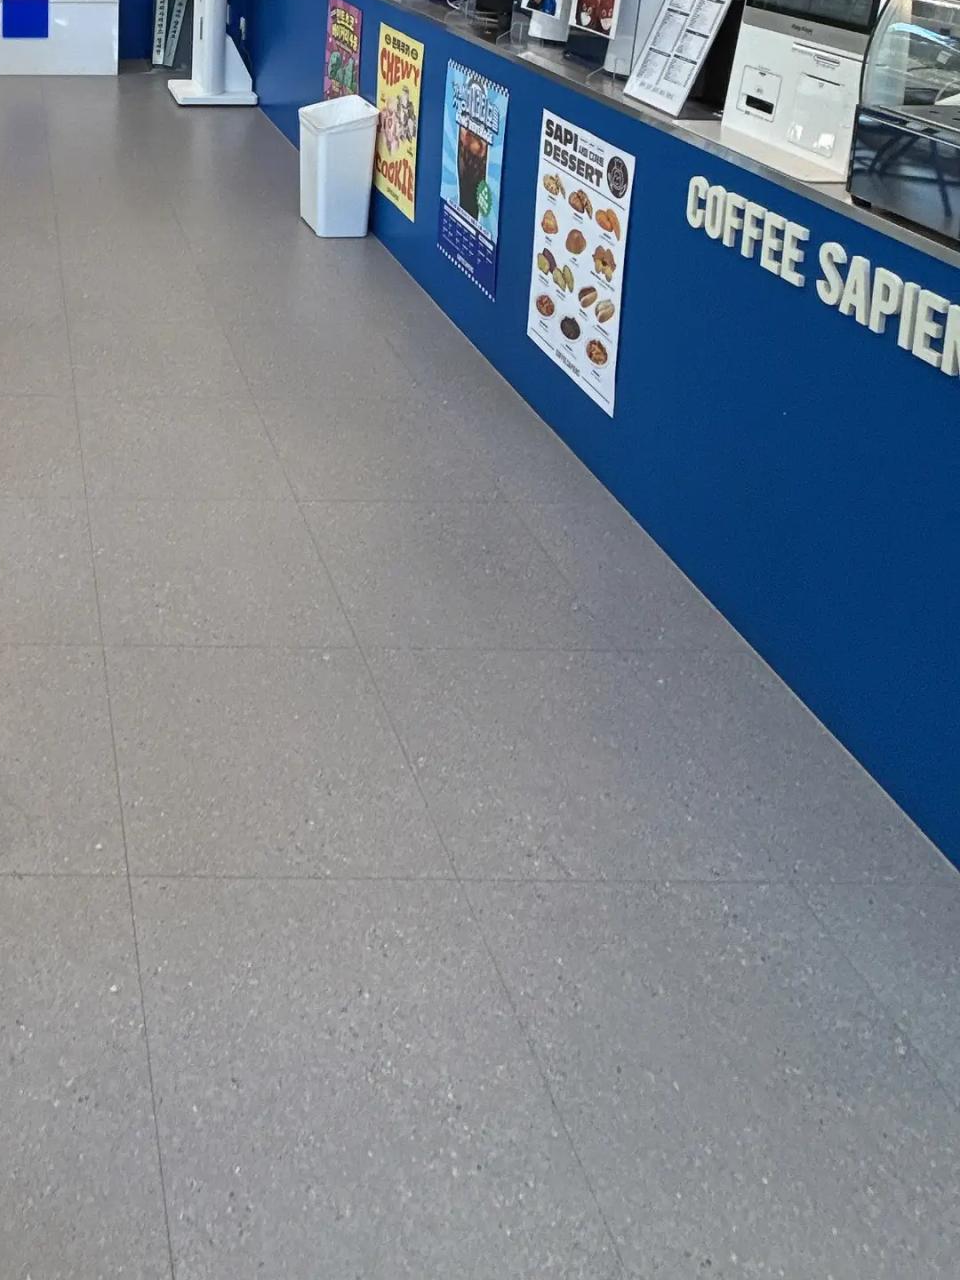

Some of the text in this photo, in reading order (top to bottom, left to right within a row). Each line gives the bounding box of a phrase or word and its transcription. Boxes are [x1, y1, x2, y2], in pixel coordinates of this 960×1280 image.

[381, 47, 420, 87] CHEWY
[545, 118, 579, 153] SAPI
[375, 151, 413, 202] COOKIE
[543, 139, 603, 188] DESSERT
[686, 176, 810, 287] COFFEE
